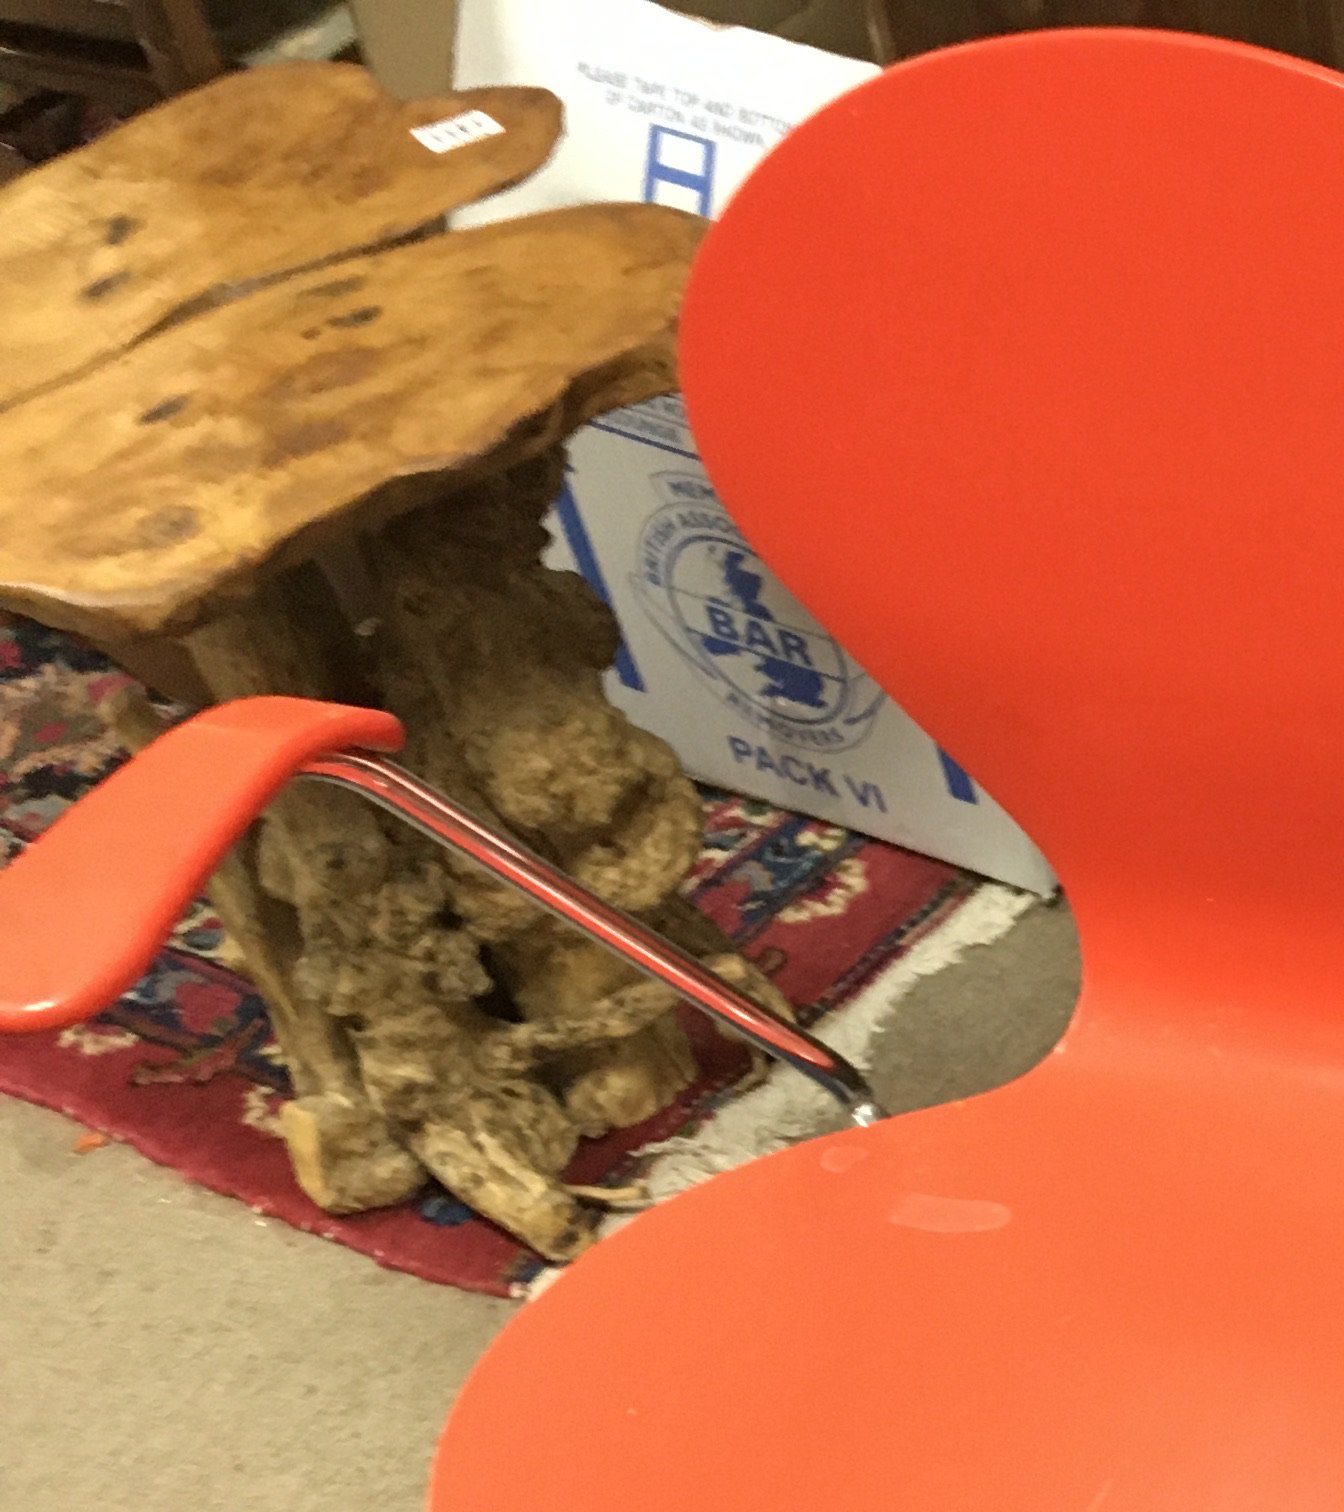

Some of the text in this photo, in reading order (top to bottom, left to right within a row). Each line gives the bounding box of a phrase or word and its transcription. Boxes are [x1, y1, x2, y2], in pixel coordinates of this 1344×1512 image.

[666, 479, 719, 501] MEM
[705, 605, 813, 667] BAR
[727, 735, 841, 798] PACK
